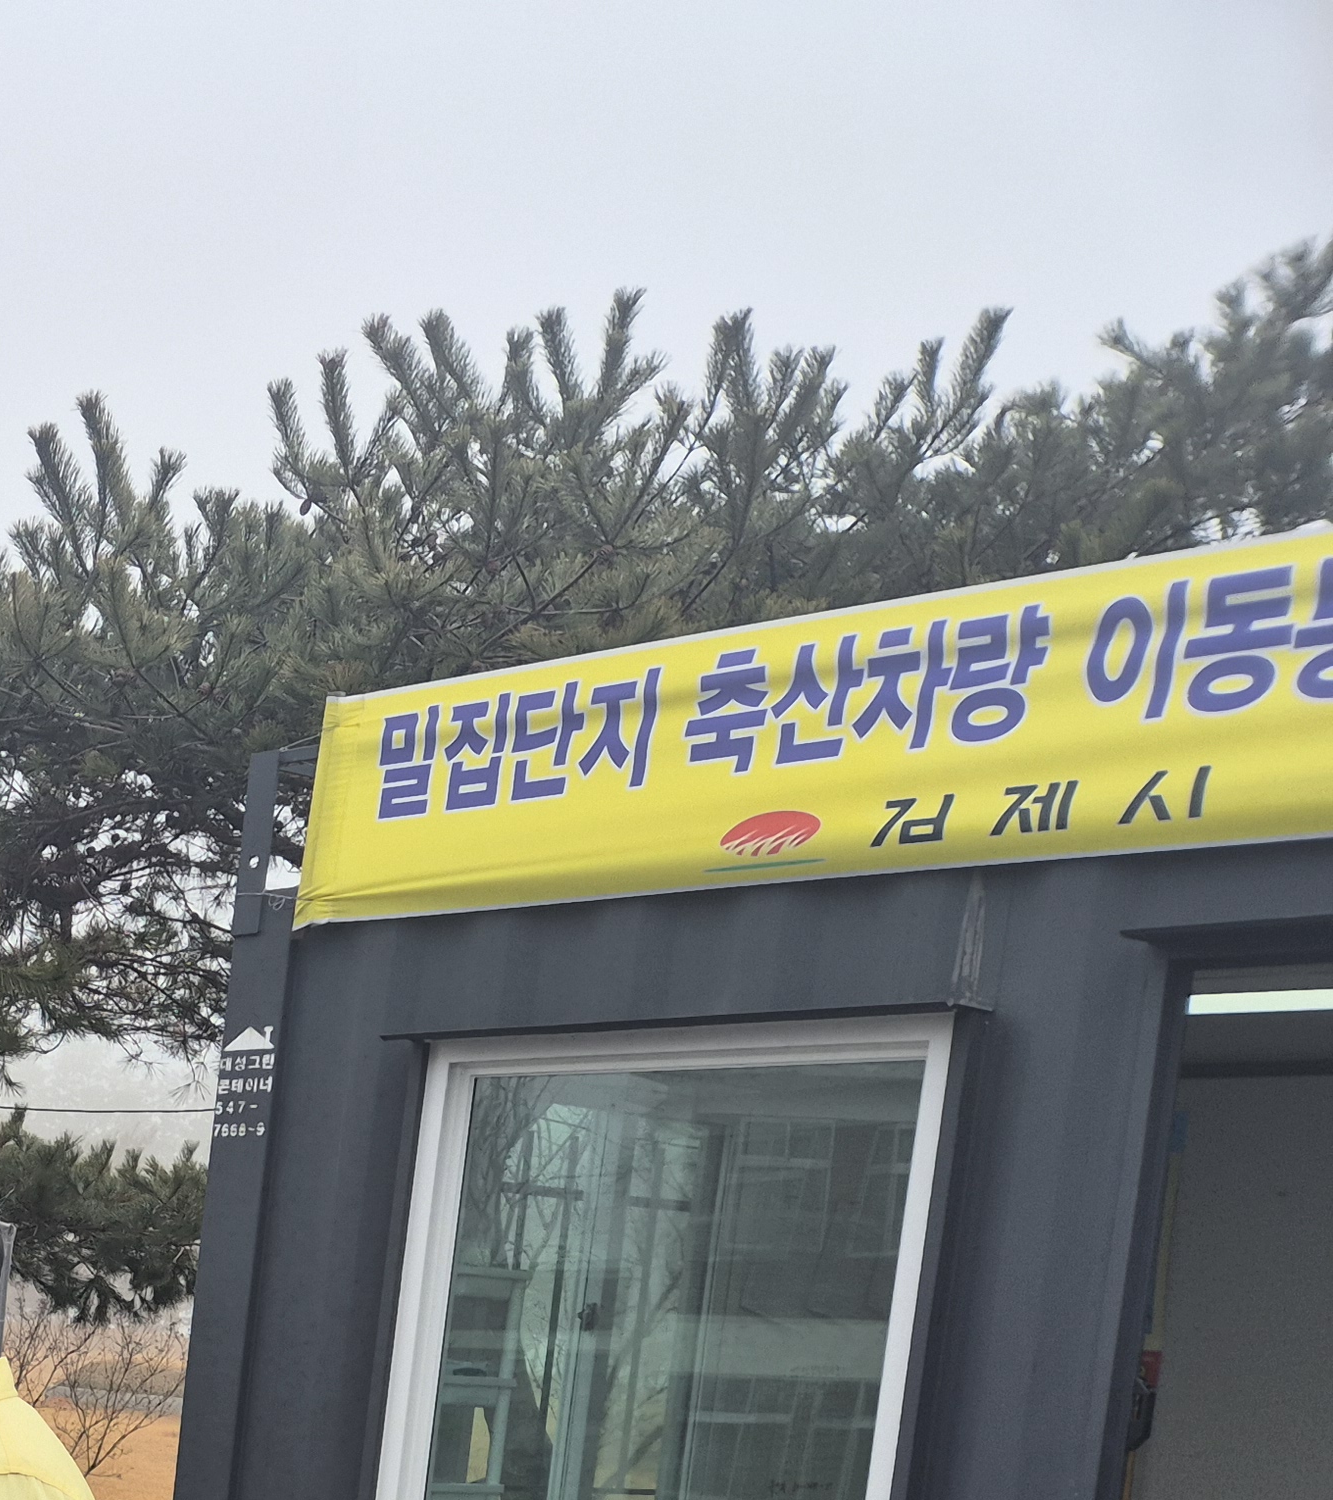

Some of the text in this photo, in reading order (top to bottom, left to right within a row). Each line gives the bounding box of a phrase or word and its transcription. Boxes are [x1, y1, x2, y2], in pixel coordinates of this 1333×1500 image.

[378, 667, 662, 820] 밀집단지
[684, 604, 1051, 774] 축산차량
[220, 1053, 275, 1071] 대성그린
[218, 1075, 273, 1095] 콘테이너
